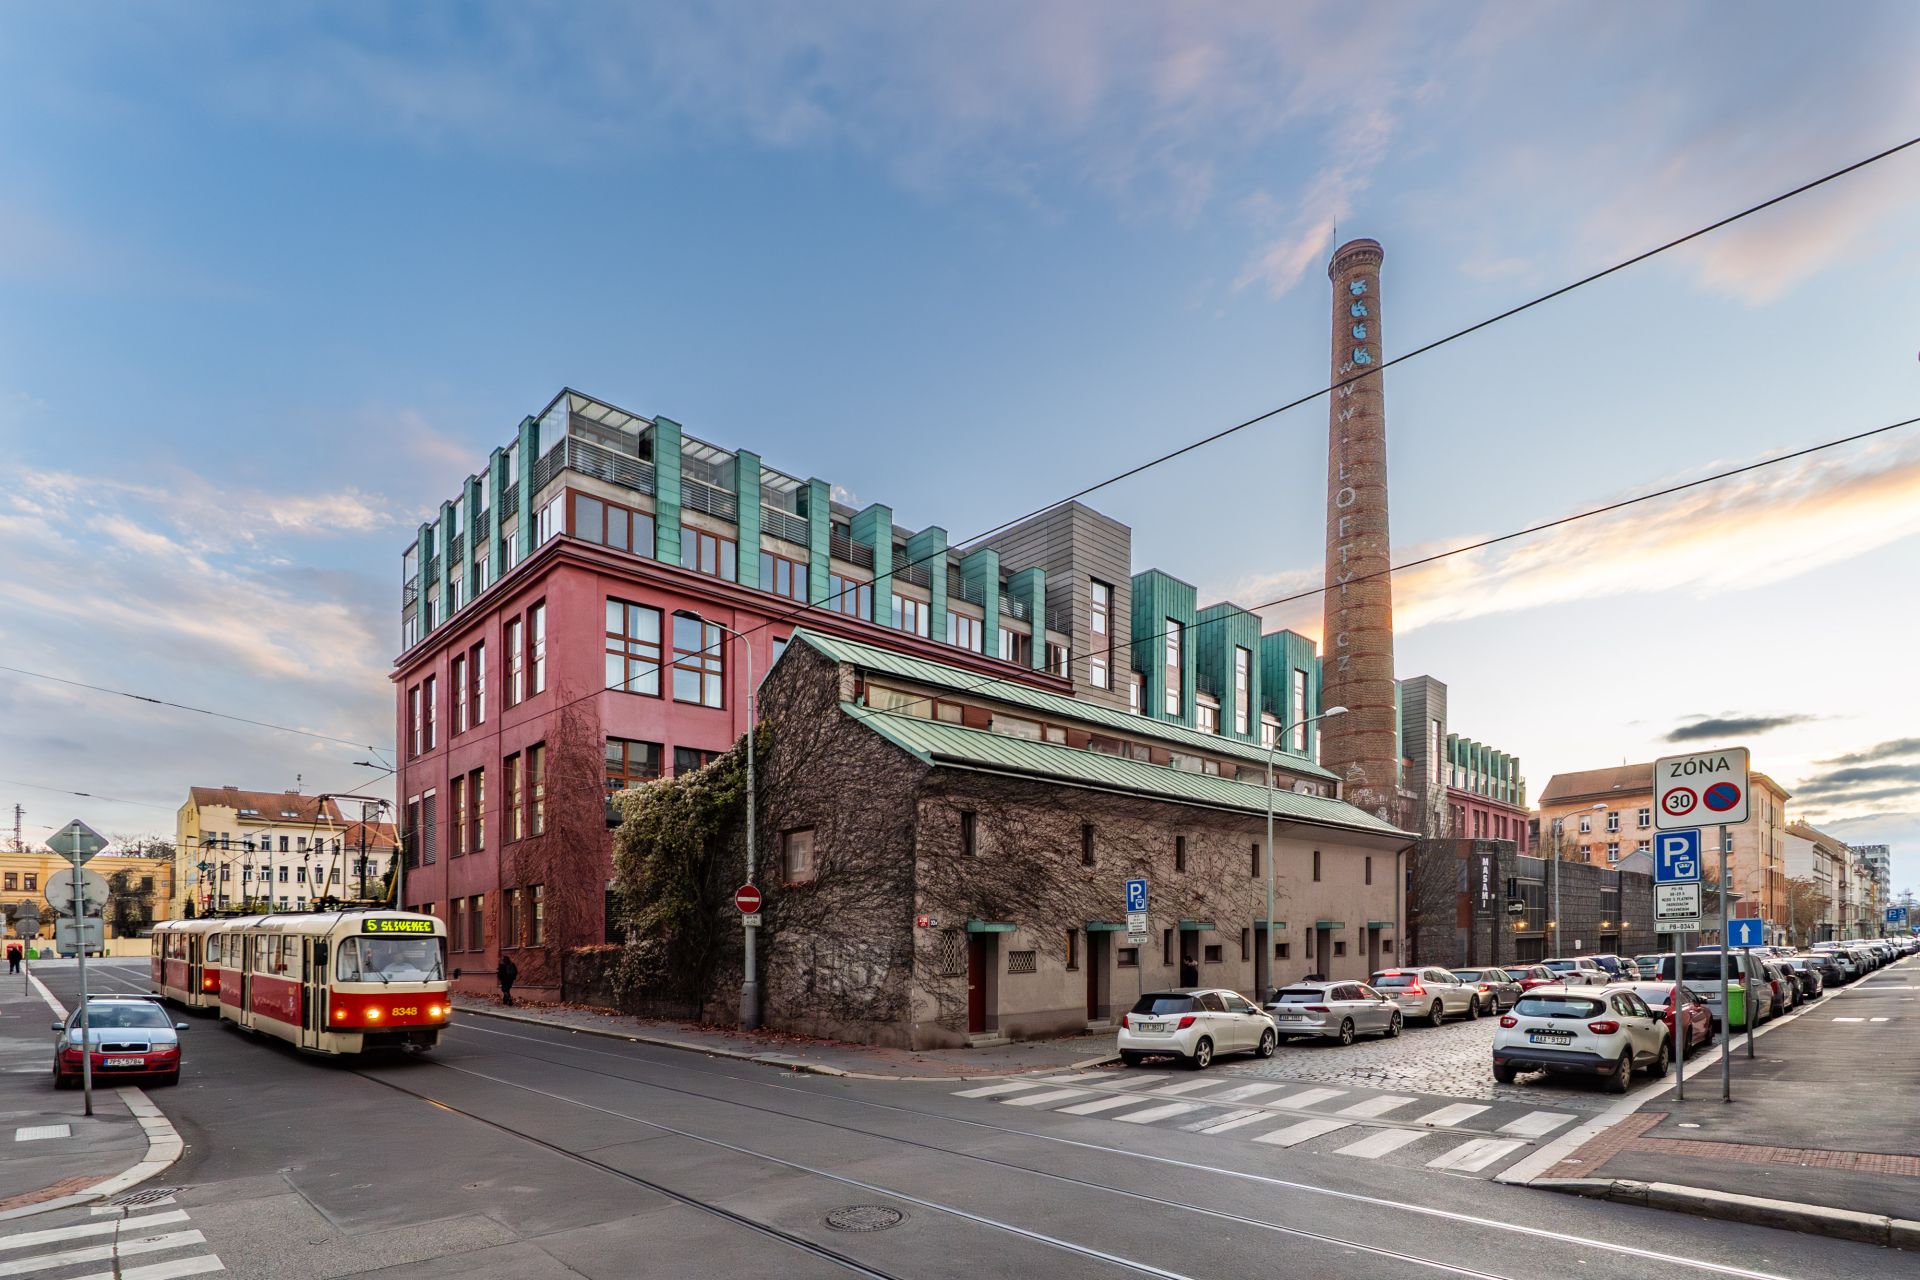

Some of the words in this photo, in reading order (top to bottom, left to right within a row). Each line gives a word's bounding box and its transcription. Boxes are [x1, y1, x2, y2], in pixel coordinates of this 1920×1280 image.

[1670, 757, 1731, 778] ZÓNA
[1669, 794, 1690, 809] 30
[1664, 837, 1690, 867] P
[1130, 883, 1142, 903] P
[367, 919, 378, 931] 5
[391, 1007, 418, 1016] 8348
